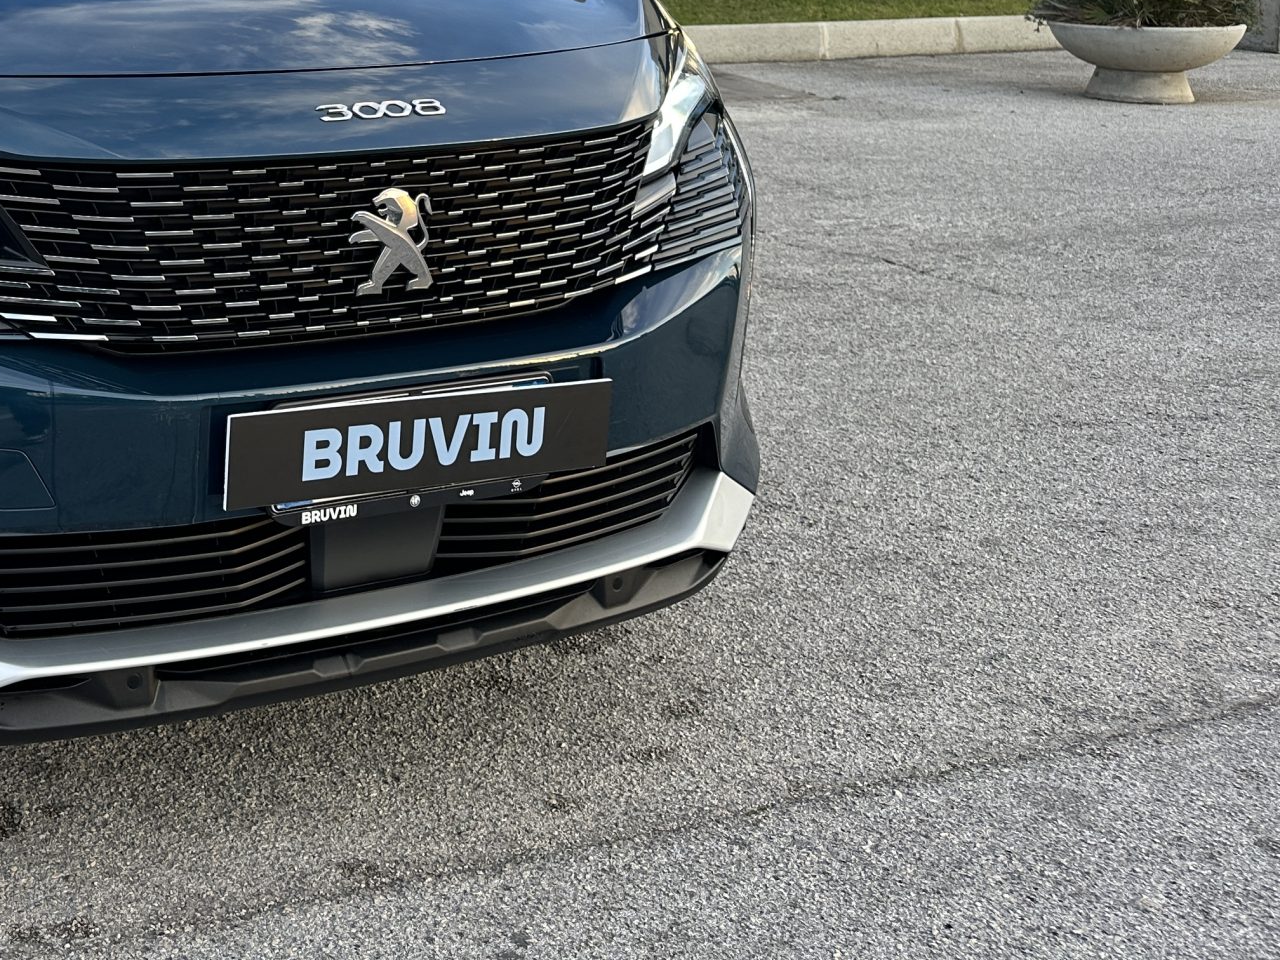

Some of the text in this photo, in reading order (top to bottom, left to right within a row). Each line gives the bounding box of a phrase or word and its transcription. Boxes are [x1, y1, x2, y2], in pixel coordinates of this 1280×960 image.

[314, 98, 447, 122] 3008
[301, 406, 546, 482] BRUVIN
[301, 503, 358, 525] BRUVIN
